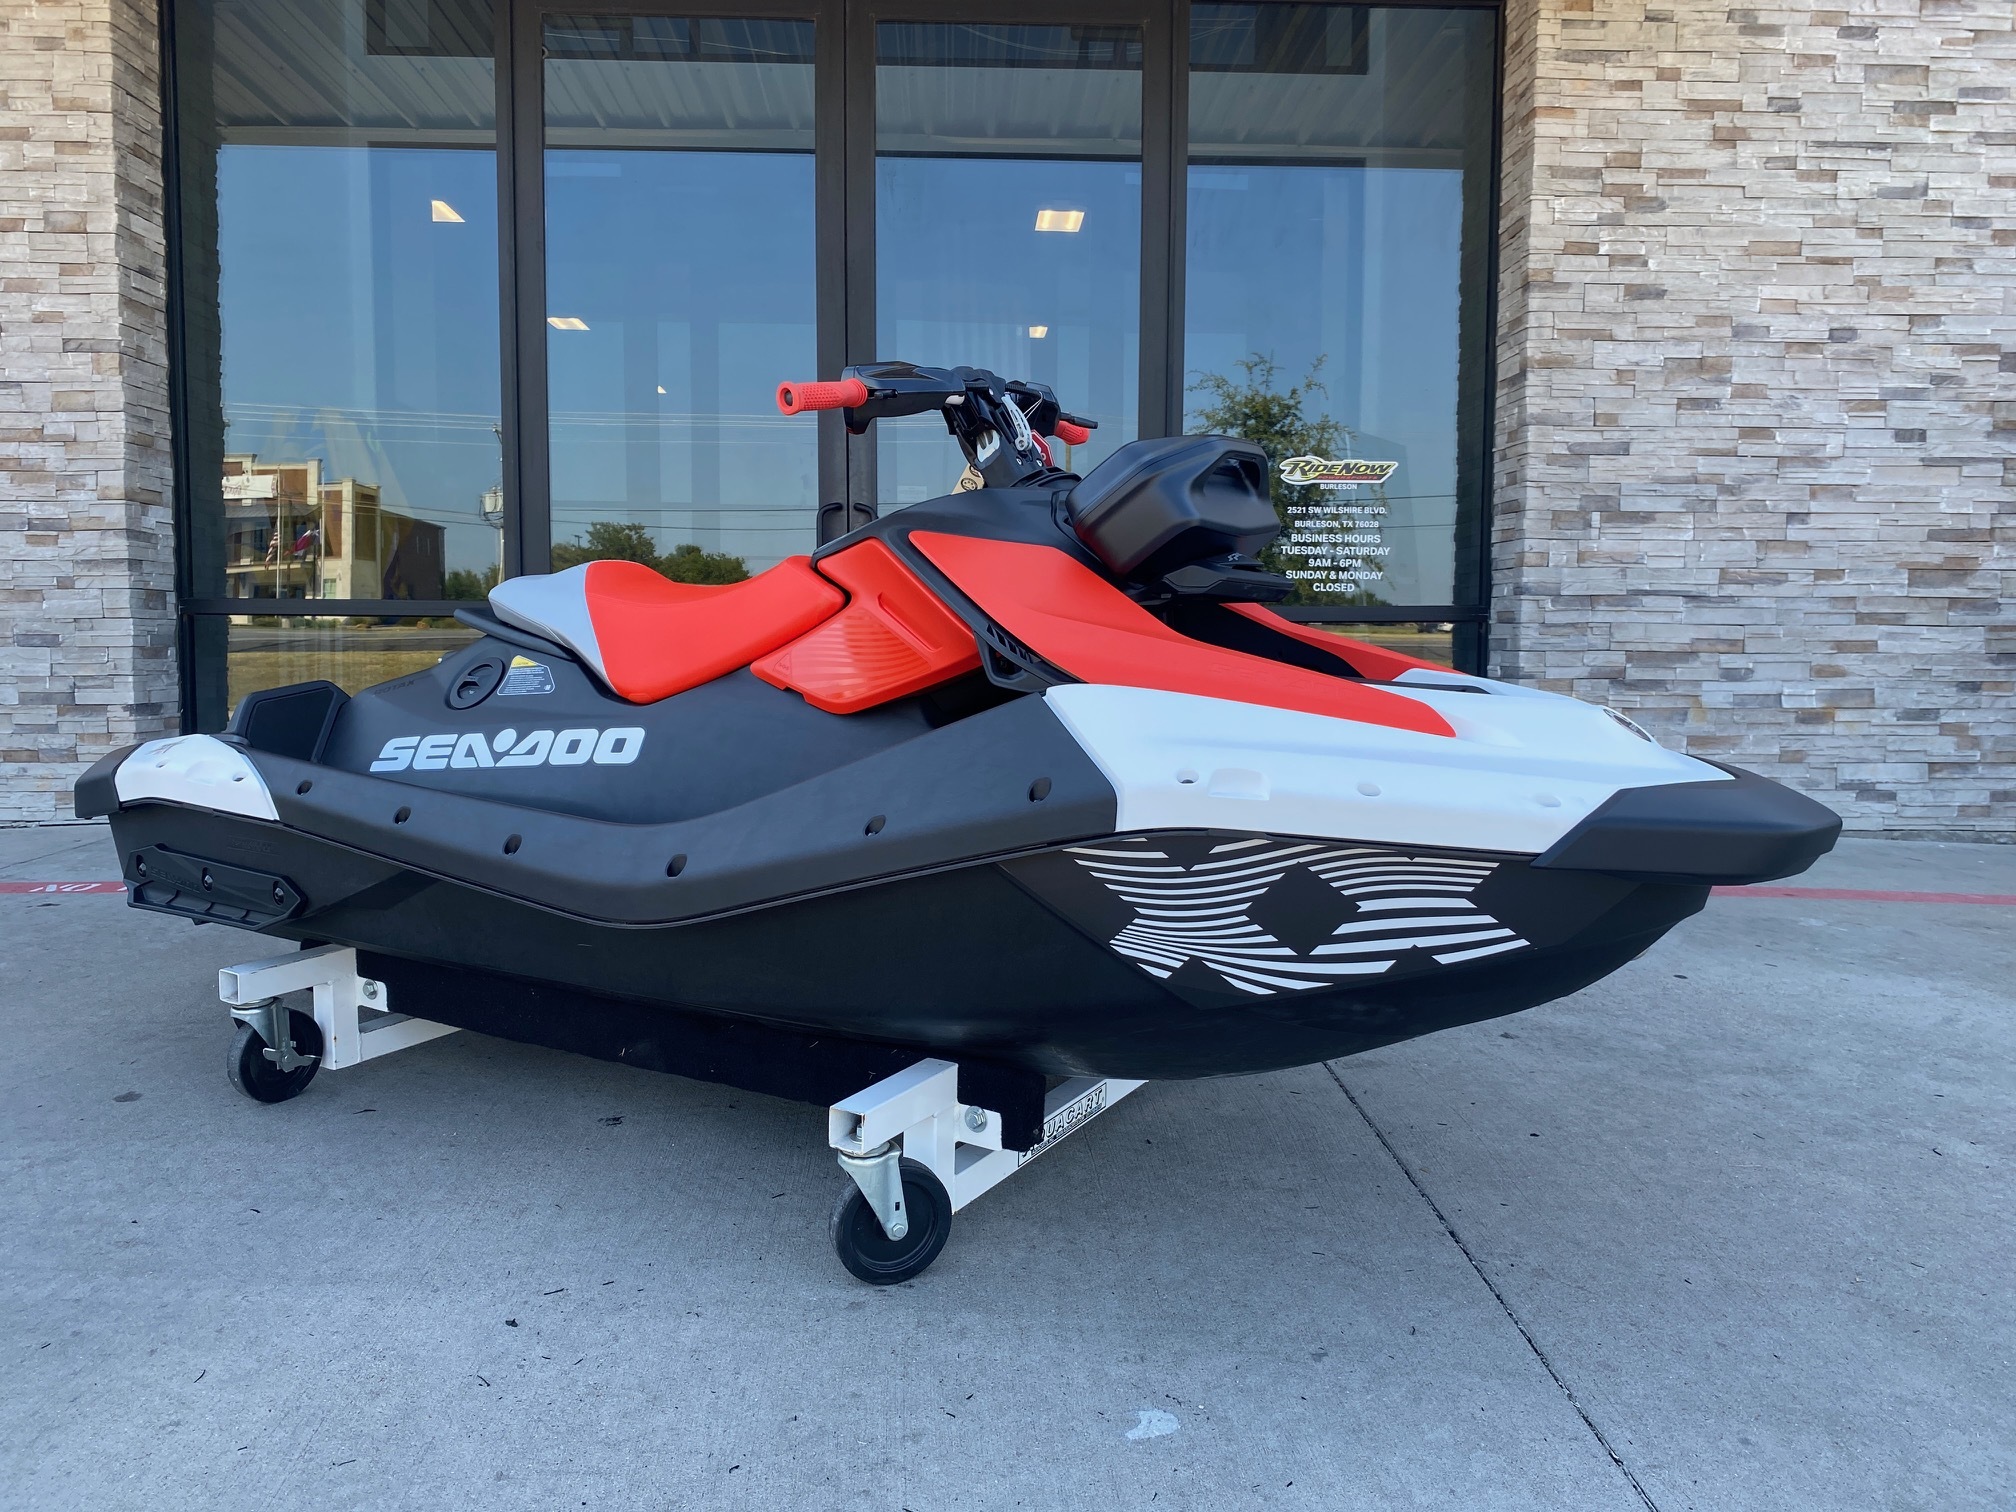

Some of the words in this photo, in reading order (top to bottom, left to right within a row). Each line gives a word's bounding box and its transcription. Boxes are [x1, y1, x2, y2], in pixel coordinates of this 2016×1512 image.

[1287, 506, 1306, 514] 2521
[1308, 506, 1322, 514] SW
[1294, 520, 1341, 529] BURLESON,
[1291, 533, 1343, 543] BUSINESS
[1344, 534, 1381, 544] HOURS
[1281, 545, 1327, 555] TUESDAY
[1336, 546, 1390, 556] SATURDAY
[1308, 558, 1331, 567] 9AM
[1339, 558, 1362, 567] 6PM
[1285, 570, 1327, 580] SUNDAY
[1329, 571, 1337, 579] &
[1338, 571, 1383, 580] MONDAY
[1312, 582, 1355, 592] CLOSED
